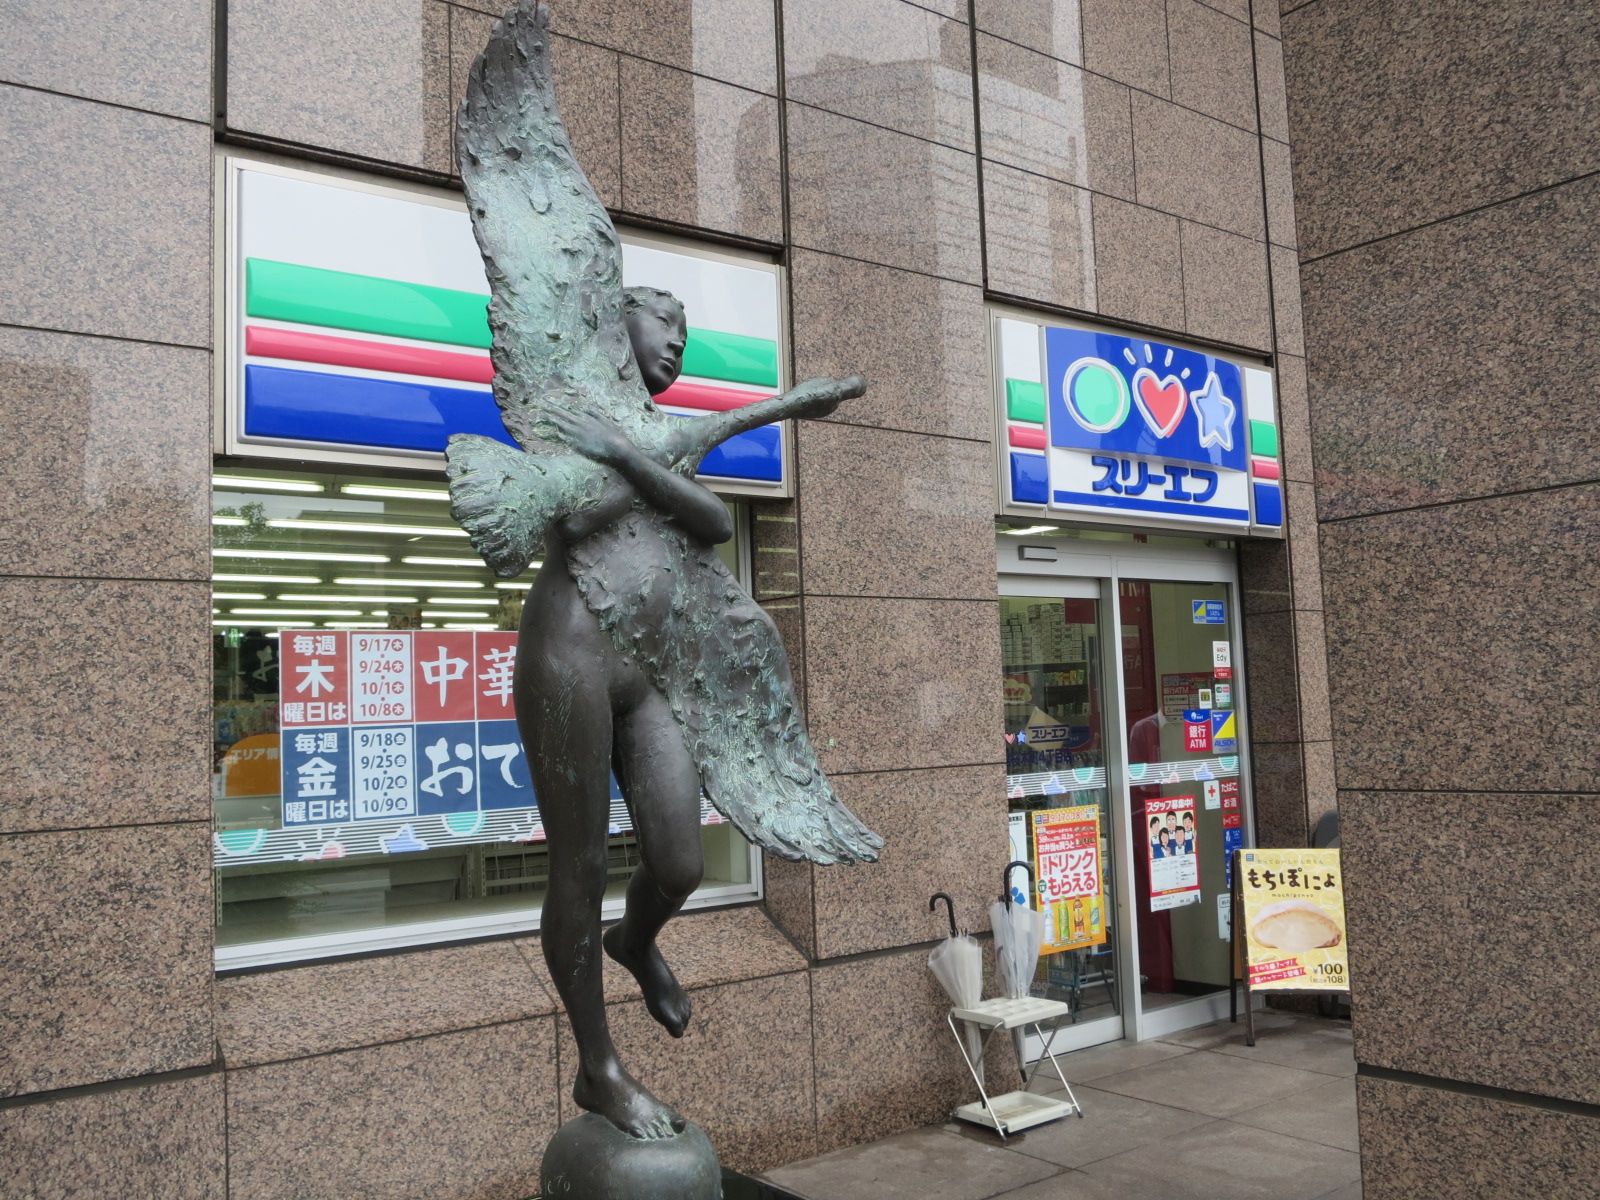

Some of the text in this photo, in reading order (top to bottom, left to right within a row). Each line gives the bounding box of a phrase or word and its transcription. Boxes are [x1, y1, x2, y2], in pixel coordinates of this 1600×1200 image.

[1091, 455, 1218, 502] スリーエフ
[292, 635, 337, 655] 毎週
[1216, 653, 1227, 662] Edy
[295, 659, 335, 698] 木
[283, 702, 347, 723] 曜日は
[1031, 728, 1068, 739] スリーエフ
[1189, 725, 1207, 738] 銀行
[294, 733, 339, 754] 毎週
[1190, 739, 1207, 749] ATM
[297, 757, 337, 797] 金
[1221, 782, 1238, 793] たばこ
[285, 799, 348, 823] 曜日は
[1048, 850, 1094, 875] ドリンク
[1048, 871, 1096, 896] もらえる
